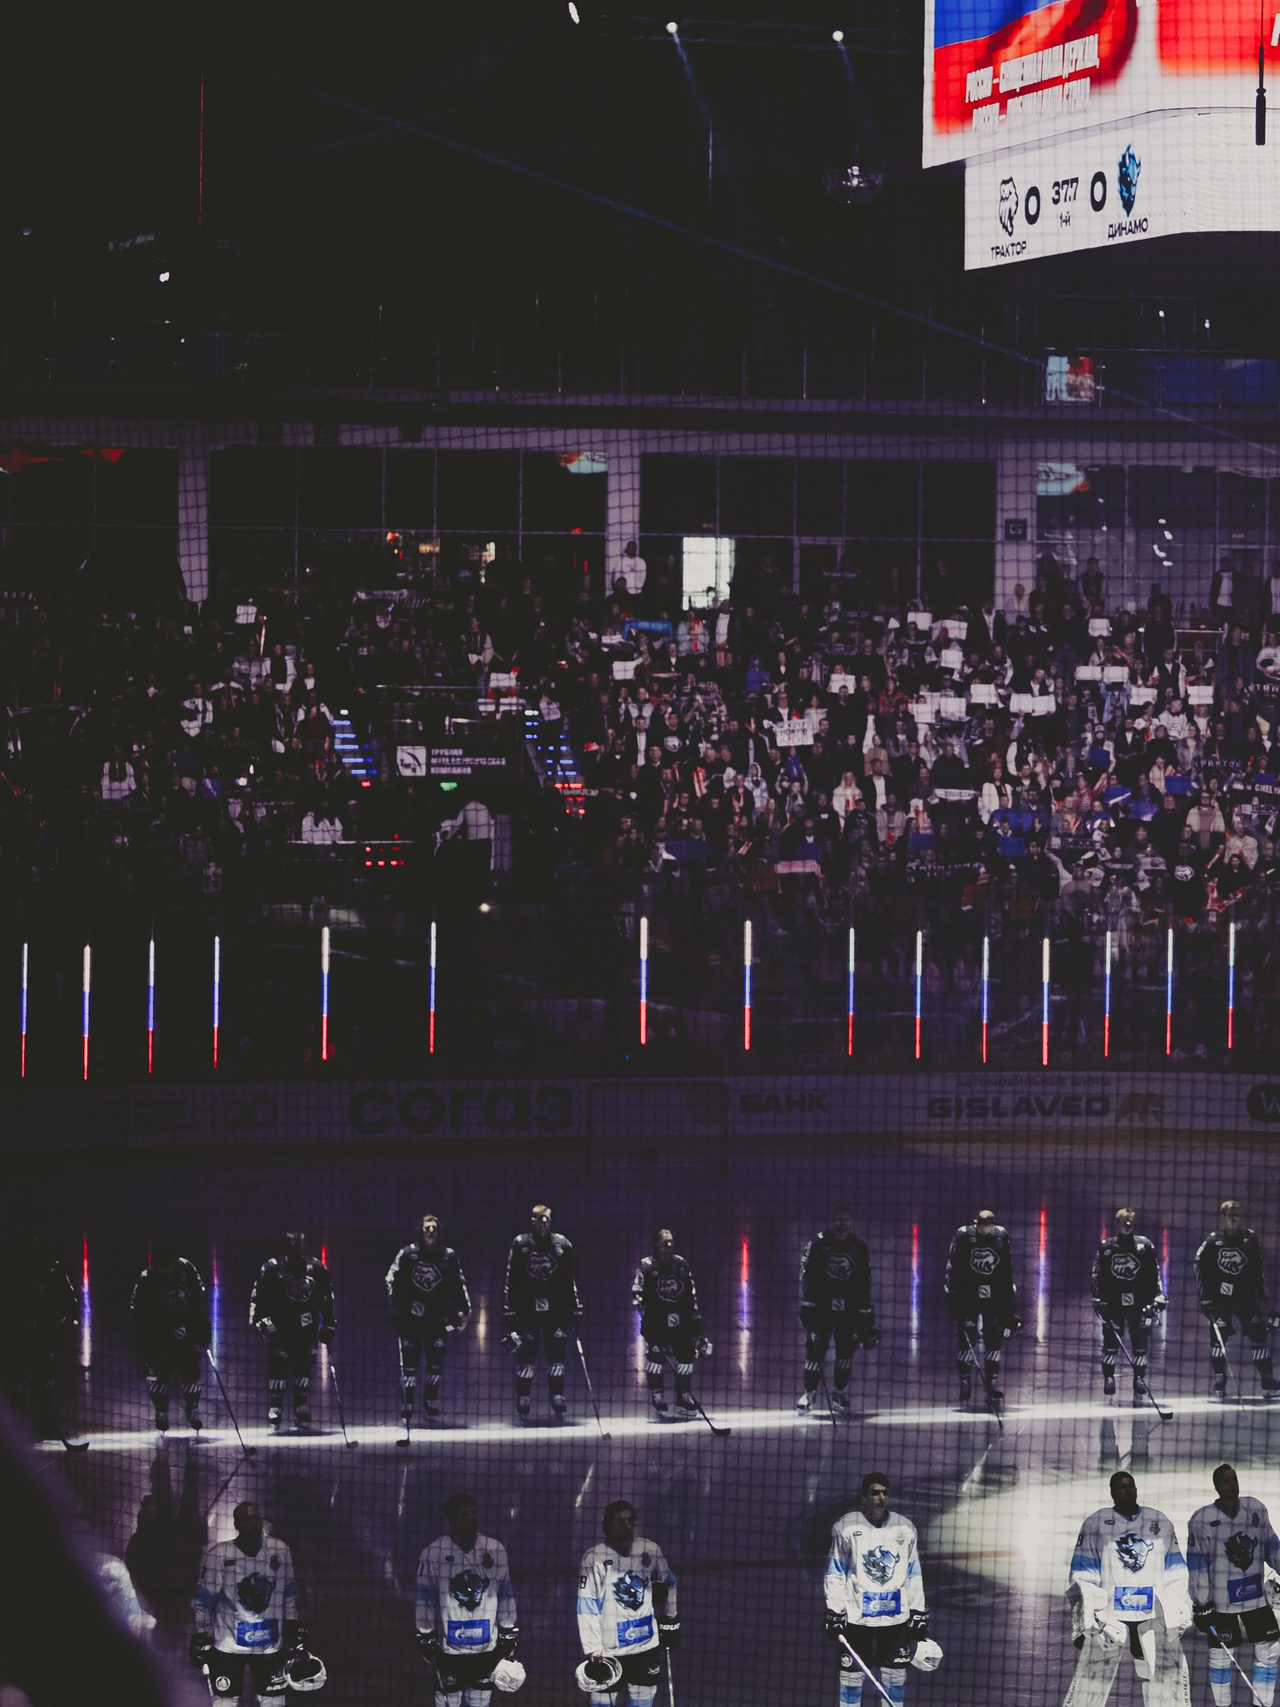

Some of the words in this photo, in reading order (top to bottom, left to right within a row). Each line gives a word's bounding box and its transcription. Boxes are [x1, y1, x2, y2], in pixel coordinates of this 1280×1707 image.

[1025, 186, 1041, 226] 0
[1052, 177, 1079, 206] 37.7
[1090, 171, 1107, 212] 0
[1107, 217, 1149, 241] ДИНАМО
[990, 240, 1027, 260] ТРАКТОР
[740, 1093, 828, 1114] БАНК
[927, 1095, 1111, 1118] GISLAVED
